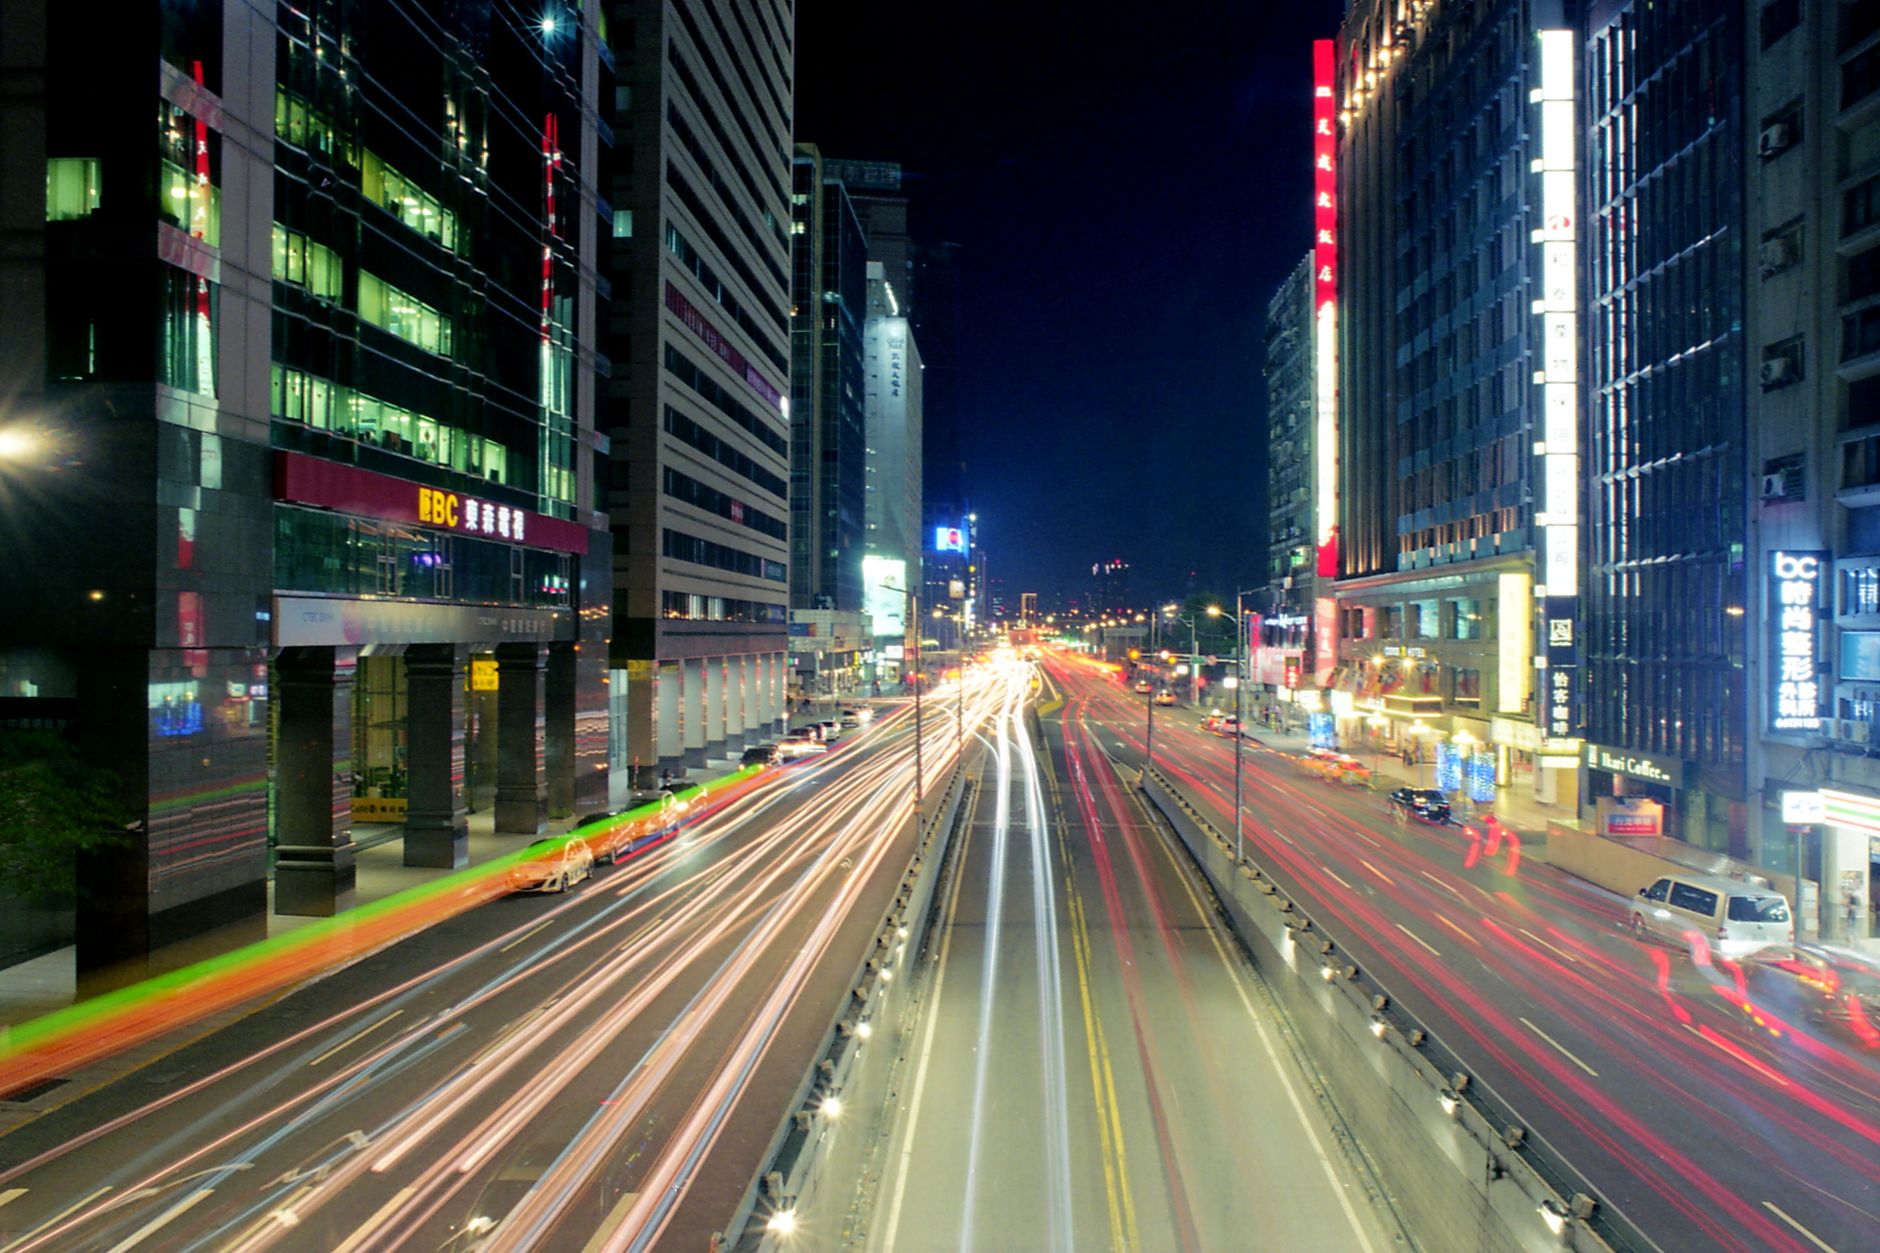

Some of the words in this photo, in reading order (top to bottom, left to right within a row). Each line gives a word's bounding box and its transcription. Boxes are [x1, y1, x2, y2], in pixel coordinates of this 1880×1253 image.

[419, 488, 458, 526] EBC
[465, 499, 524, 540] 東森電視
[1774, 551, 1818, 579] bc
[1780, 580, 1813, 681] 時尚整形
[1552, 671, 1569, 735] 怡客咖啡
[1627, 758, 1662, 779] Coffee
